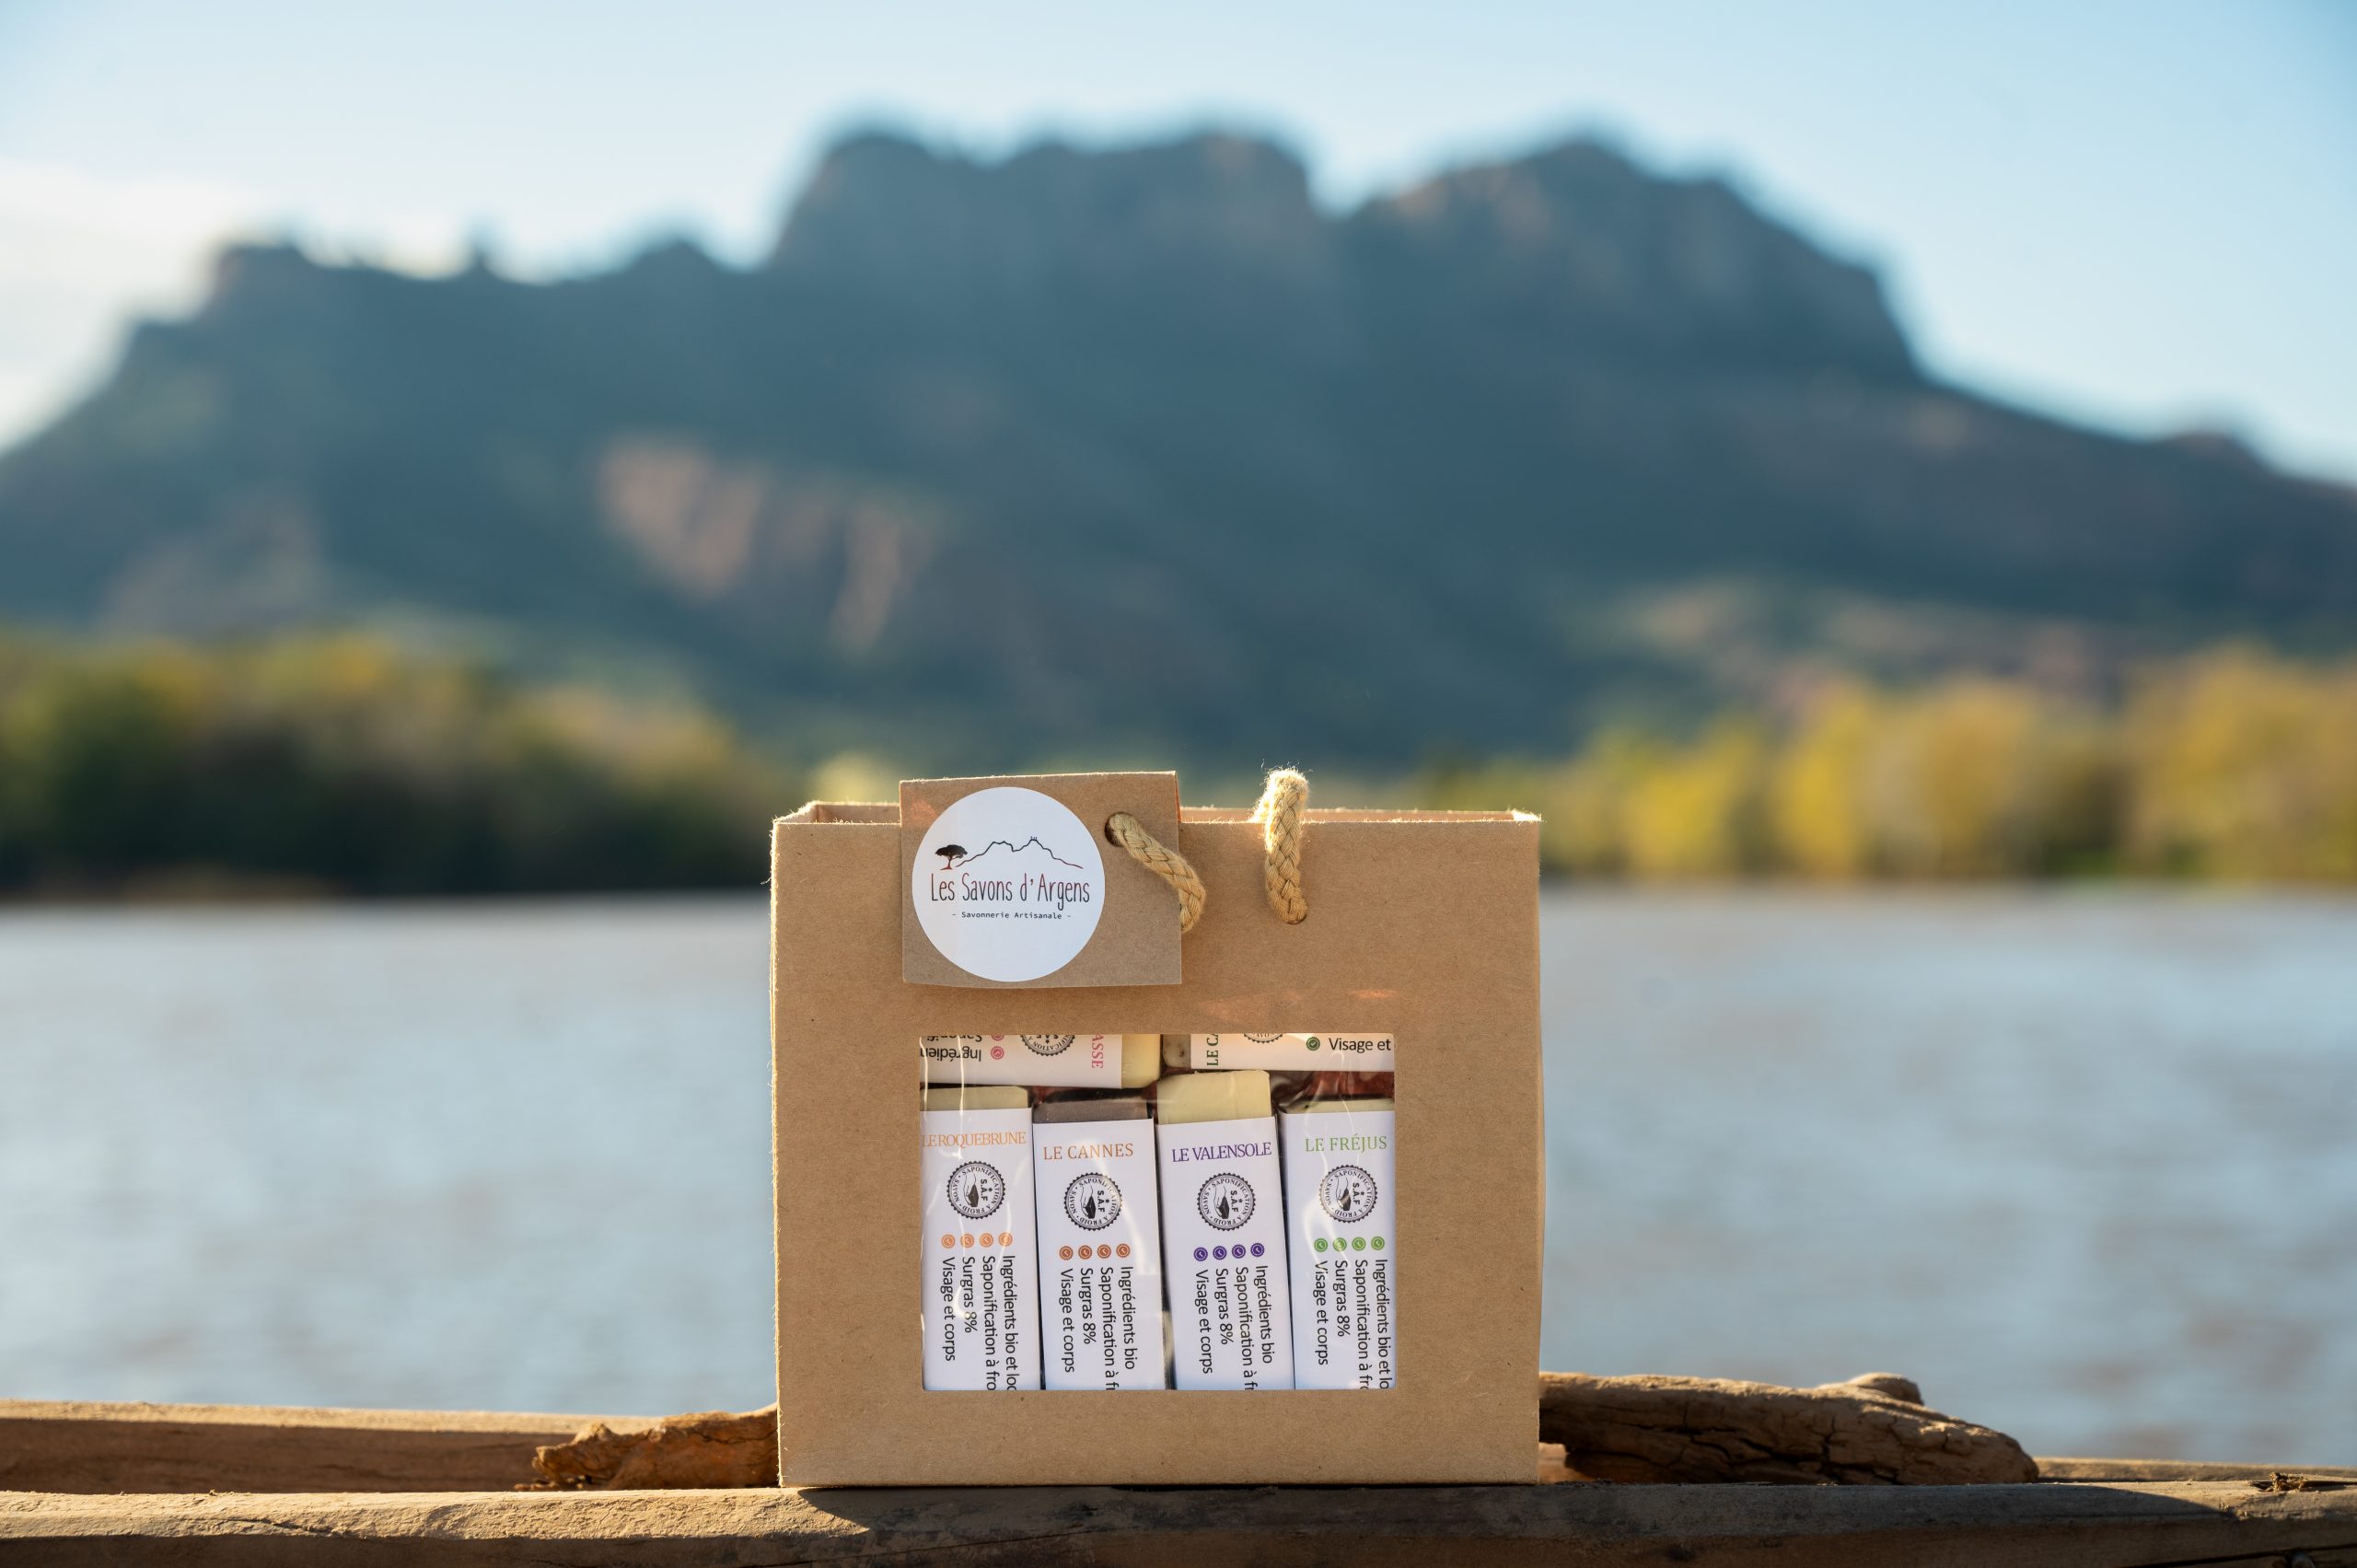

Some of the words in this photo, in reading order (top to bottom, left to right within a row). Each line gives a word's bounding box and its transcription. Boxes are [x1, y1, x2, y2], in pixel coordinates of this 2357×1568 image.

[931, 873, 955, 901] Les
[961, 872, 1013, 901] Savons
[1020, 873, 1090, 911] d'Argens
[1014, 912, 1062, 920] Artisanale
[1329, 1038, 1374, 1053] Visage
[1377, 1039, 1391, 1051] et
[1206, 1050, 1219, 1066] LE
[922, 1133, 937, 1147] LE
[938, 1132, 1027, 1148] ROQUEBRUNE
[1305, 1138, 1325, 1152] LE
[1329, 1133, 1387, 1153] FRÉJUS
[1043, 1145, 1062, 1160] LE
[1067, 1143, 1133, 1159] CANNES
[1171, 1148, 1190, 1162] LE
[1191, 1142, 1272, 1161] VALENSOLE
[940, 1257, 956, 1302] Visage
[960, 1257, 975, 1307] Surgras
[1059, 1268, 1074, 1313] Visage
[1313, 1260, 1329, 1307] Visage
[1332, 1260, 1348, 1312] Surgras
[1000, 1255, 1017, 1330] Ingrédients
[1079, 1268, 1094, 1319] Surgras
[1194, 1269, 1210, 1315] Visage
[1214, 1268, 1229, 1320] Surgras
[1253, 1265, 1271, 1340] Ingrédients
[1373, 1259, 1390, 1334] Ingrédients
[944, 1306, 956, 1320] et
[980, 1256, 998, 1355] Saponification
[1098, 1267, 1117, 1366] Saponification
[1119, 1267, 1136, 1344] Ingrédients
[1234, 1266, 1254, 1366] Saponification
[1317, 1309, 1329, 1324] et
[1353, 1259, 1371, 1360] Saponification
[964, 1311, 978, 1333] 8%
[1062, 1318, 1074, 1331] et
[1083, 1322, 1097, 1344] 8%
[1199, 1318, 1212, 1333] et
[1337, 1315, 1351, 1338] 8%
[942, 1323, 956, 1362] corps
[1004, 1333, 1018, 1353] bio
[1220, 1323, 1234, 1345] 8%
[1062, 1335, 1074, 1373] corps
[1199, 1336, 1213, 1374] corps
[1261, 1342, 1275, 1364] bio
[1315, 1328, 1329, 1365] corps
[1377, 1336, 1391, 1358] bio
[986, 1359, 1000, 1367] à
[1006, 1356, 1018, 1370] et
[1124, 1348, 1138, 1370] bio
[1358, 1363, 1373, 1371] à
[1378, 1360, 1391, 1375] et
